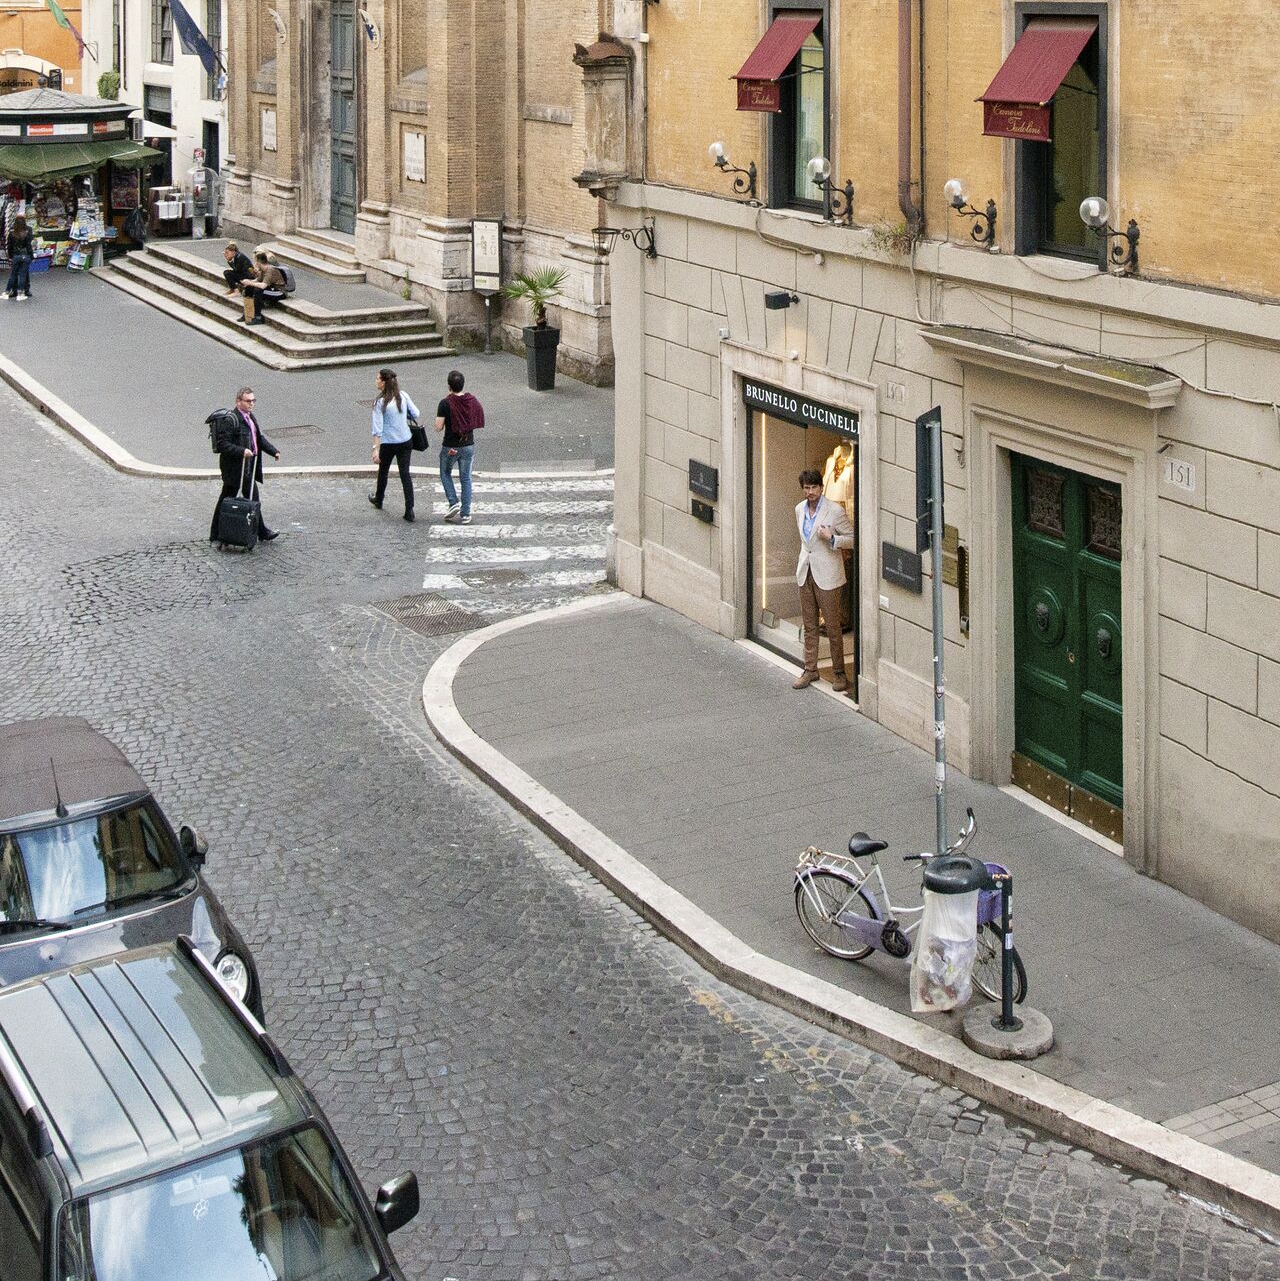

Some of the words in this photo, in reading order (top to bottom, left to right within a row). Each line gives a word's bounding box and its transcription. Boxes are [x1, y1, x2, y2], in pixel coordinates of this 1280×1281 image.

[990, 102, 1024, 117] Canova
[1006, 116, 1042, 135] Tadolini
[746, 384, 798, 413] BRUNELLO
[802, 403, 860, 435] CUCINELLI
[1170, 462, 1190, 486] 151
